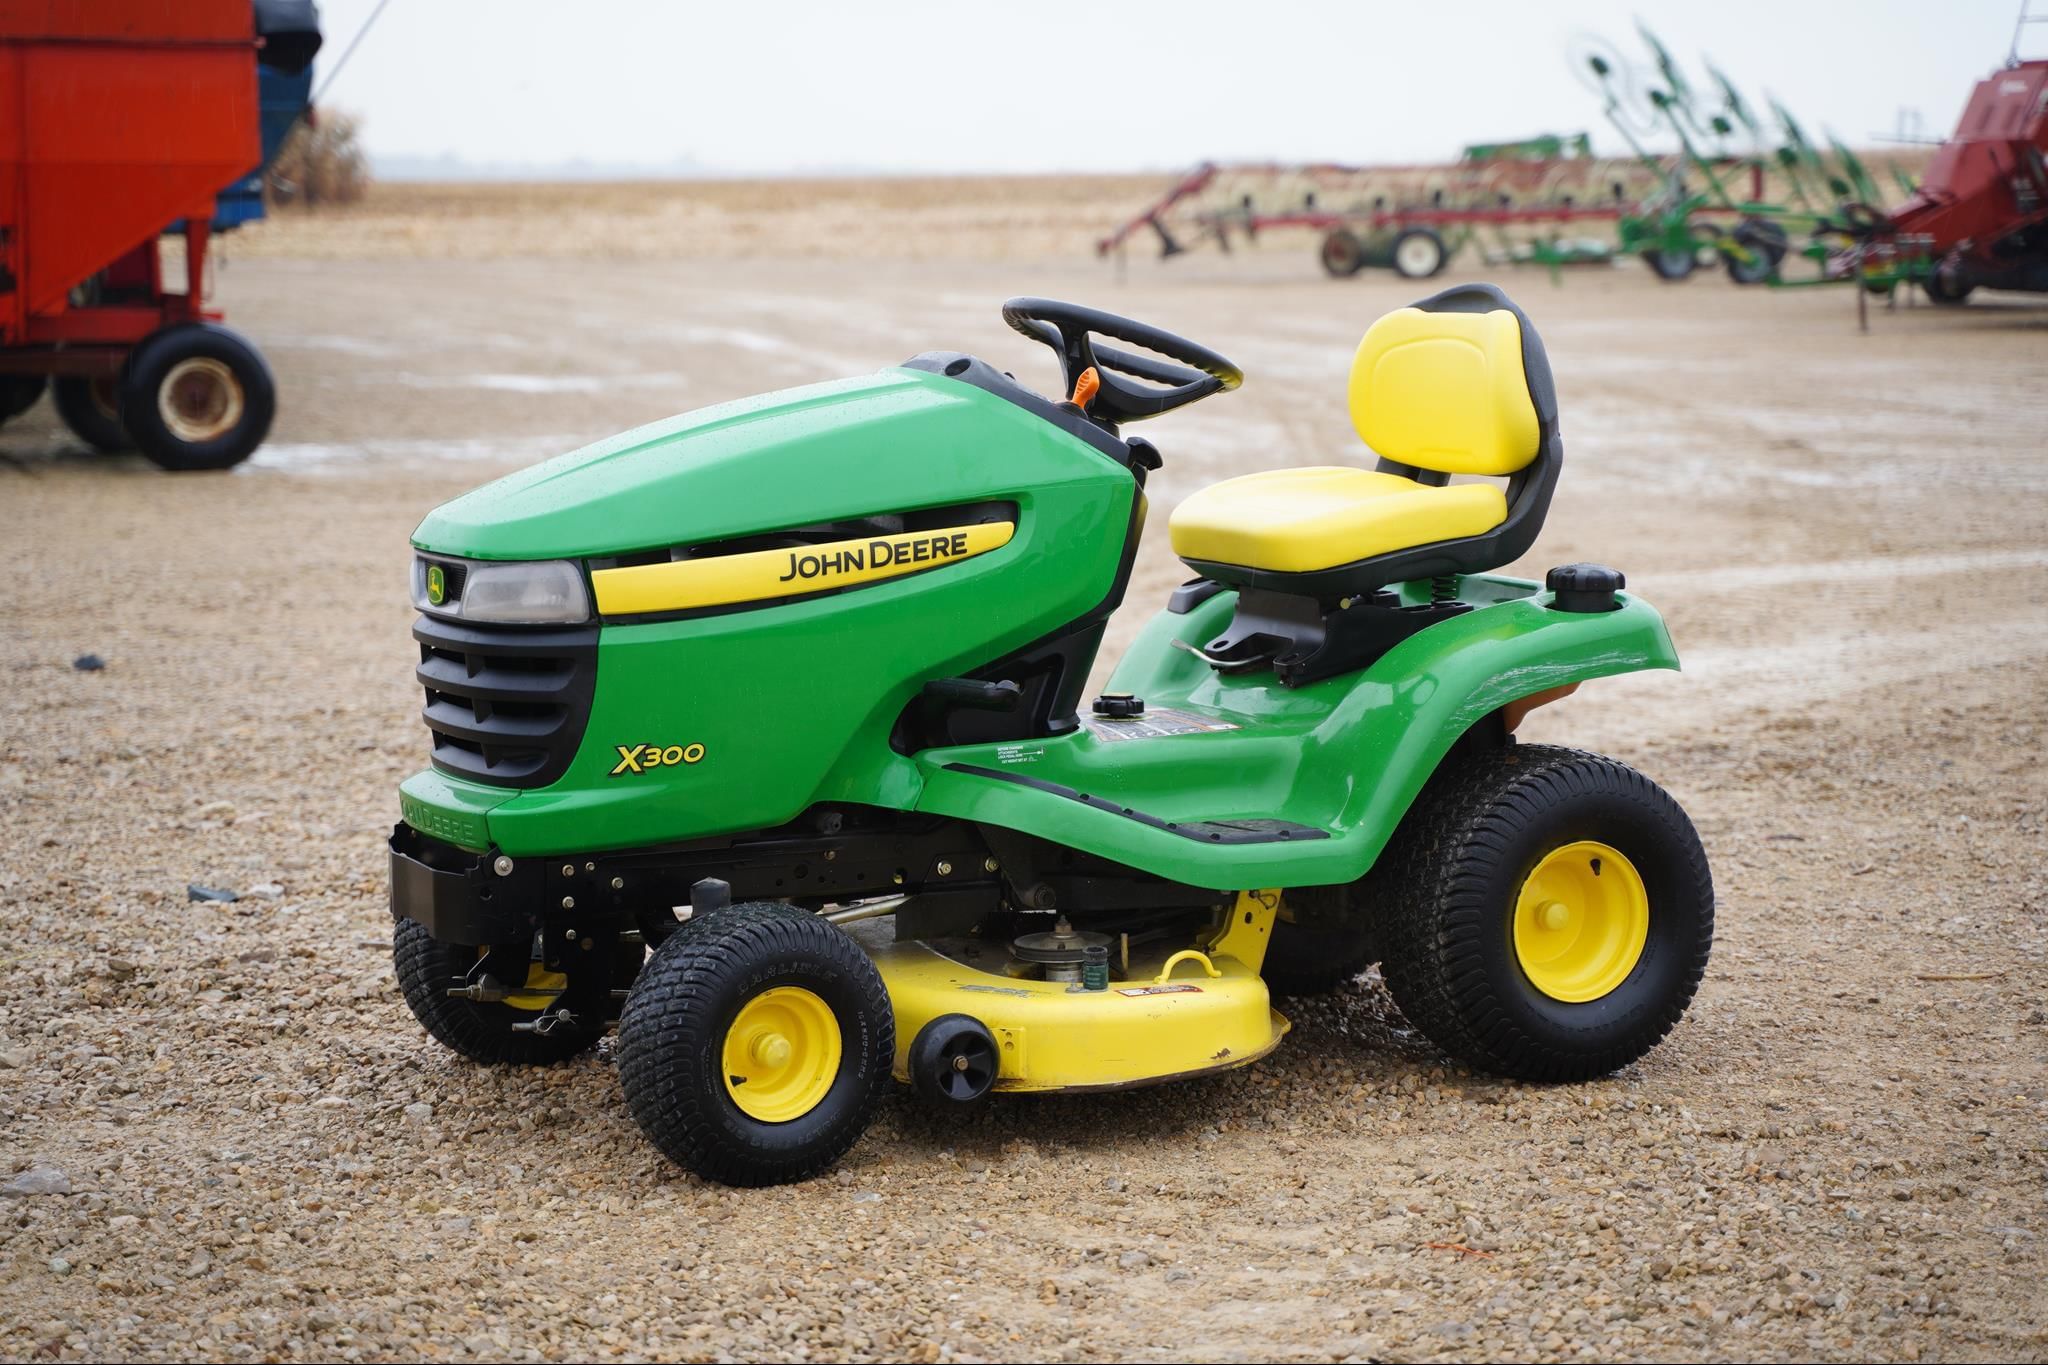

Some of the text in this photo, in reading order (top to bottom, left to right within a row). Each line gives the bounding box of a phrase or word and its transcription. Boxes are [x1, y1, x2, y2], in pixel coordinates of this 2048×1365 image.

[779, 532, 968, 582] JOHN DEERE
[609, 743, 705, 775] X300
[422, 807, 477, 844] DEERE
